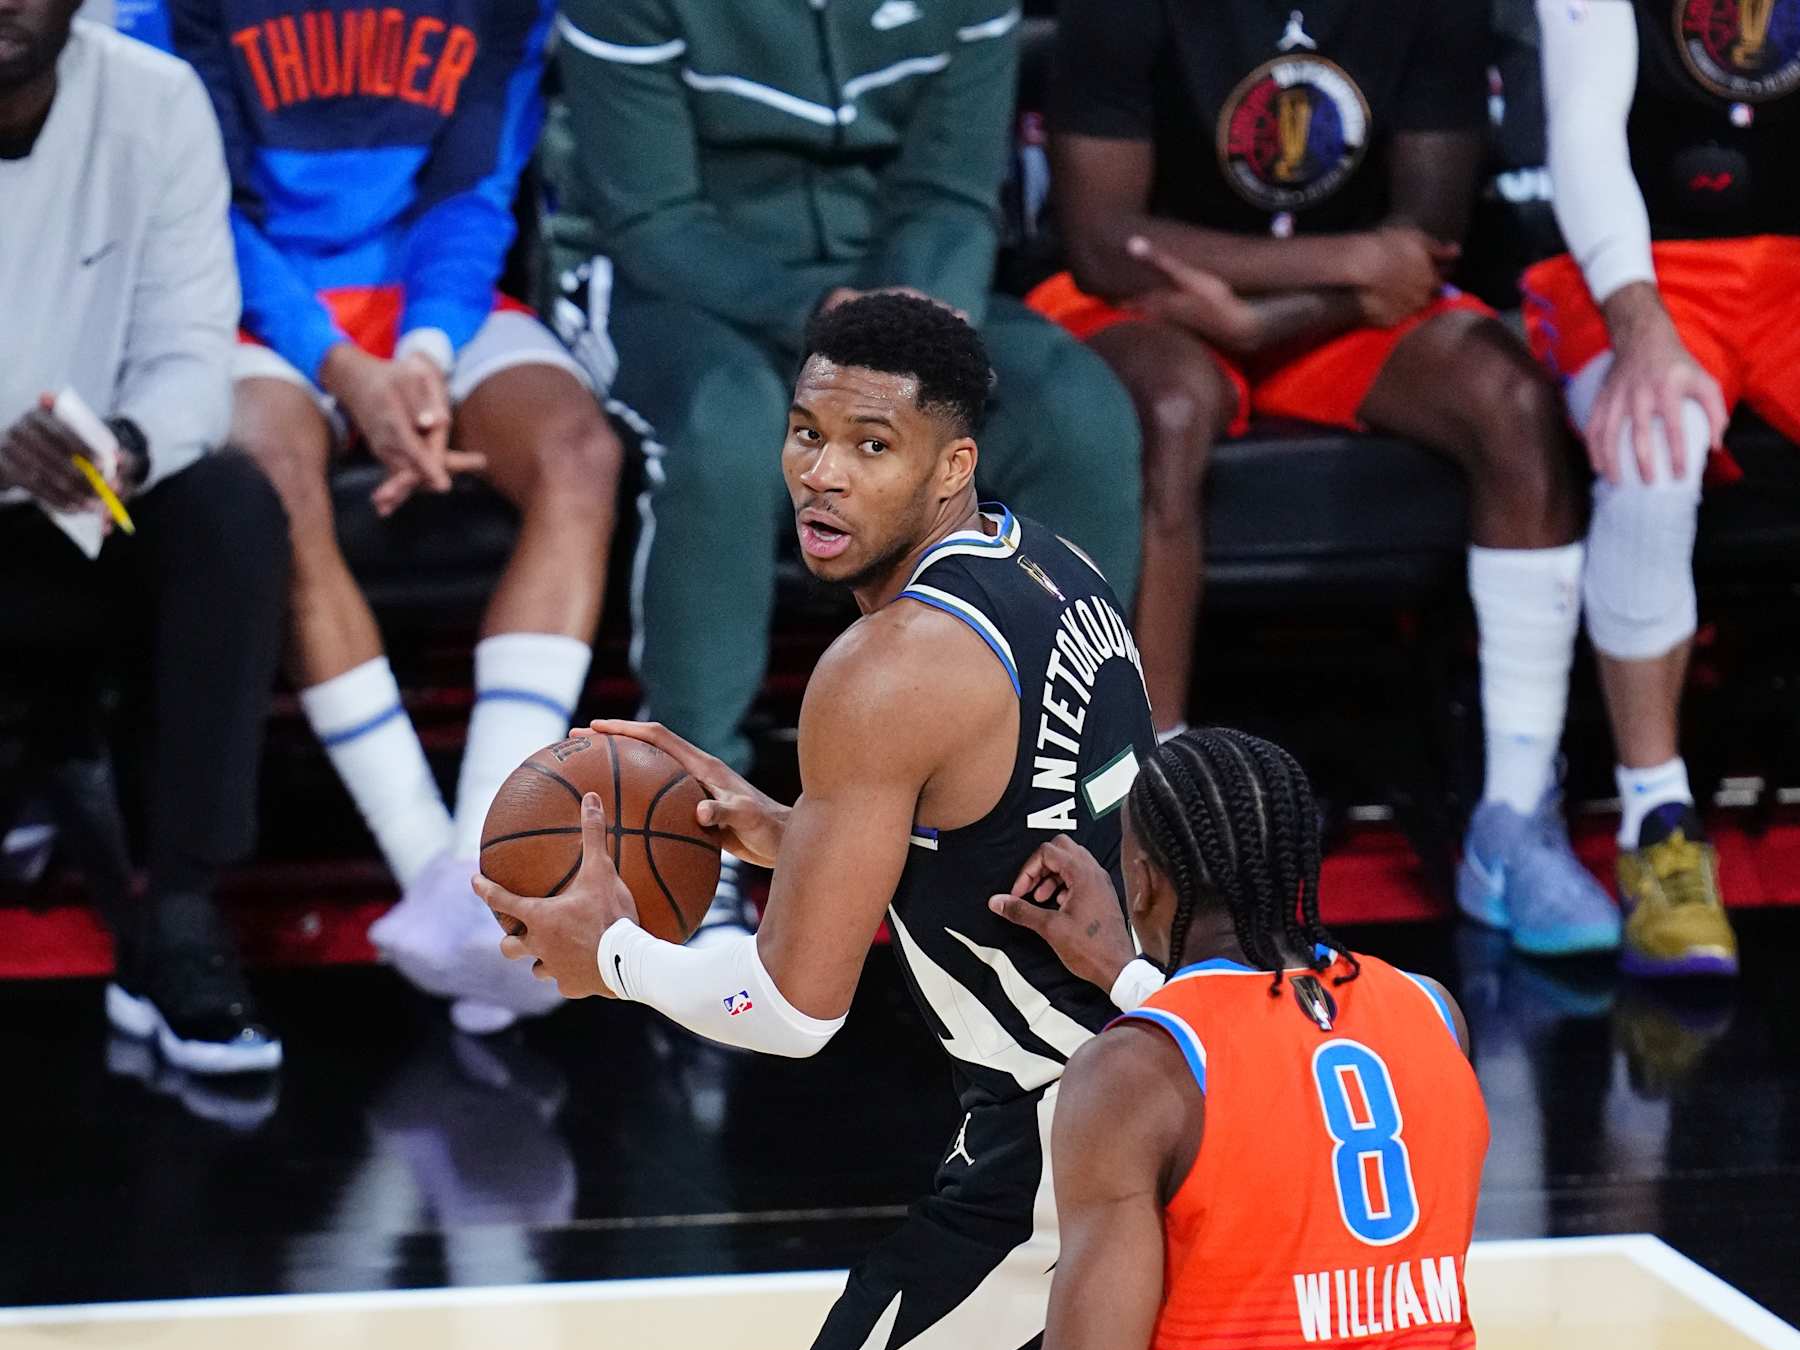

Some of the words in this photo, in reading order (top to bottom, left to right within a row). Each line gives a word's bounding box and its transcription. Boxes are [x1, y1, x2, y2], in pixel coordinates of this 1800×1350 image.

[231, 8, 478, 116] THUNDER
[1312, 1038, 1420, 1246] 8
[1293, 1255, 1464, 1342] WILLIAM
